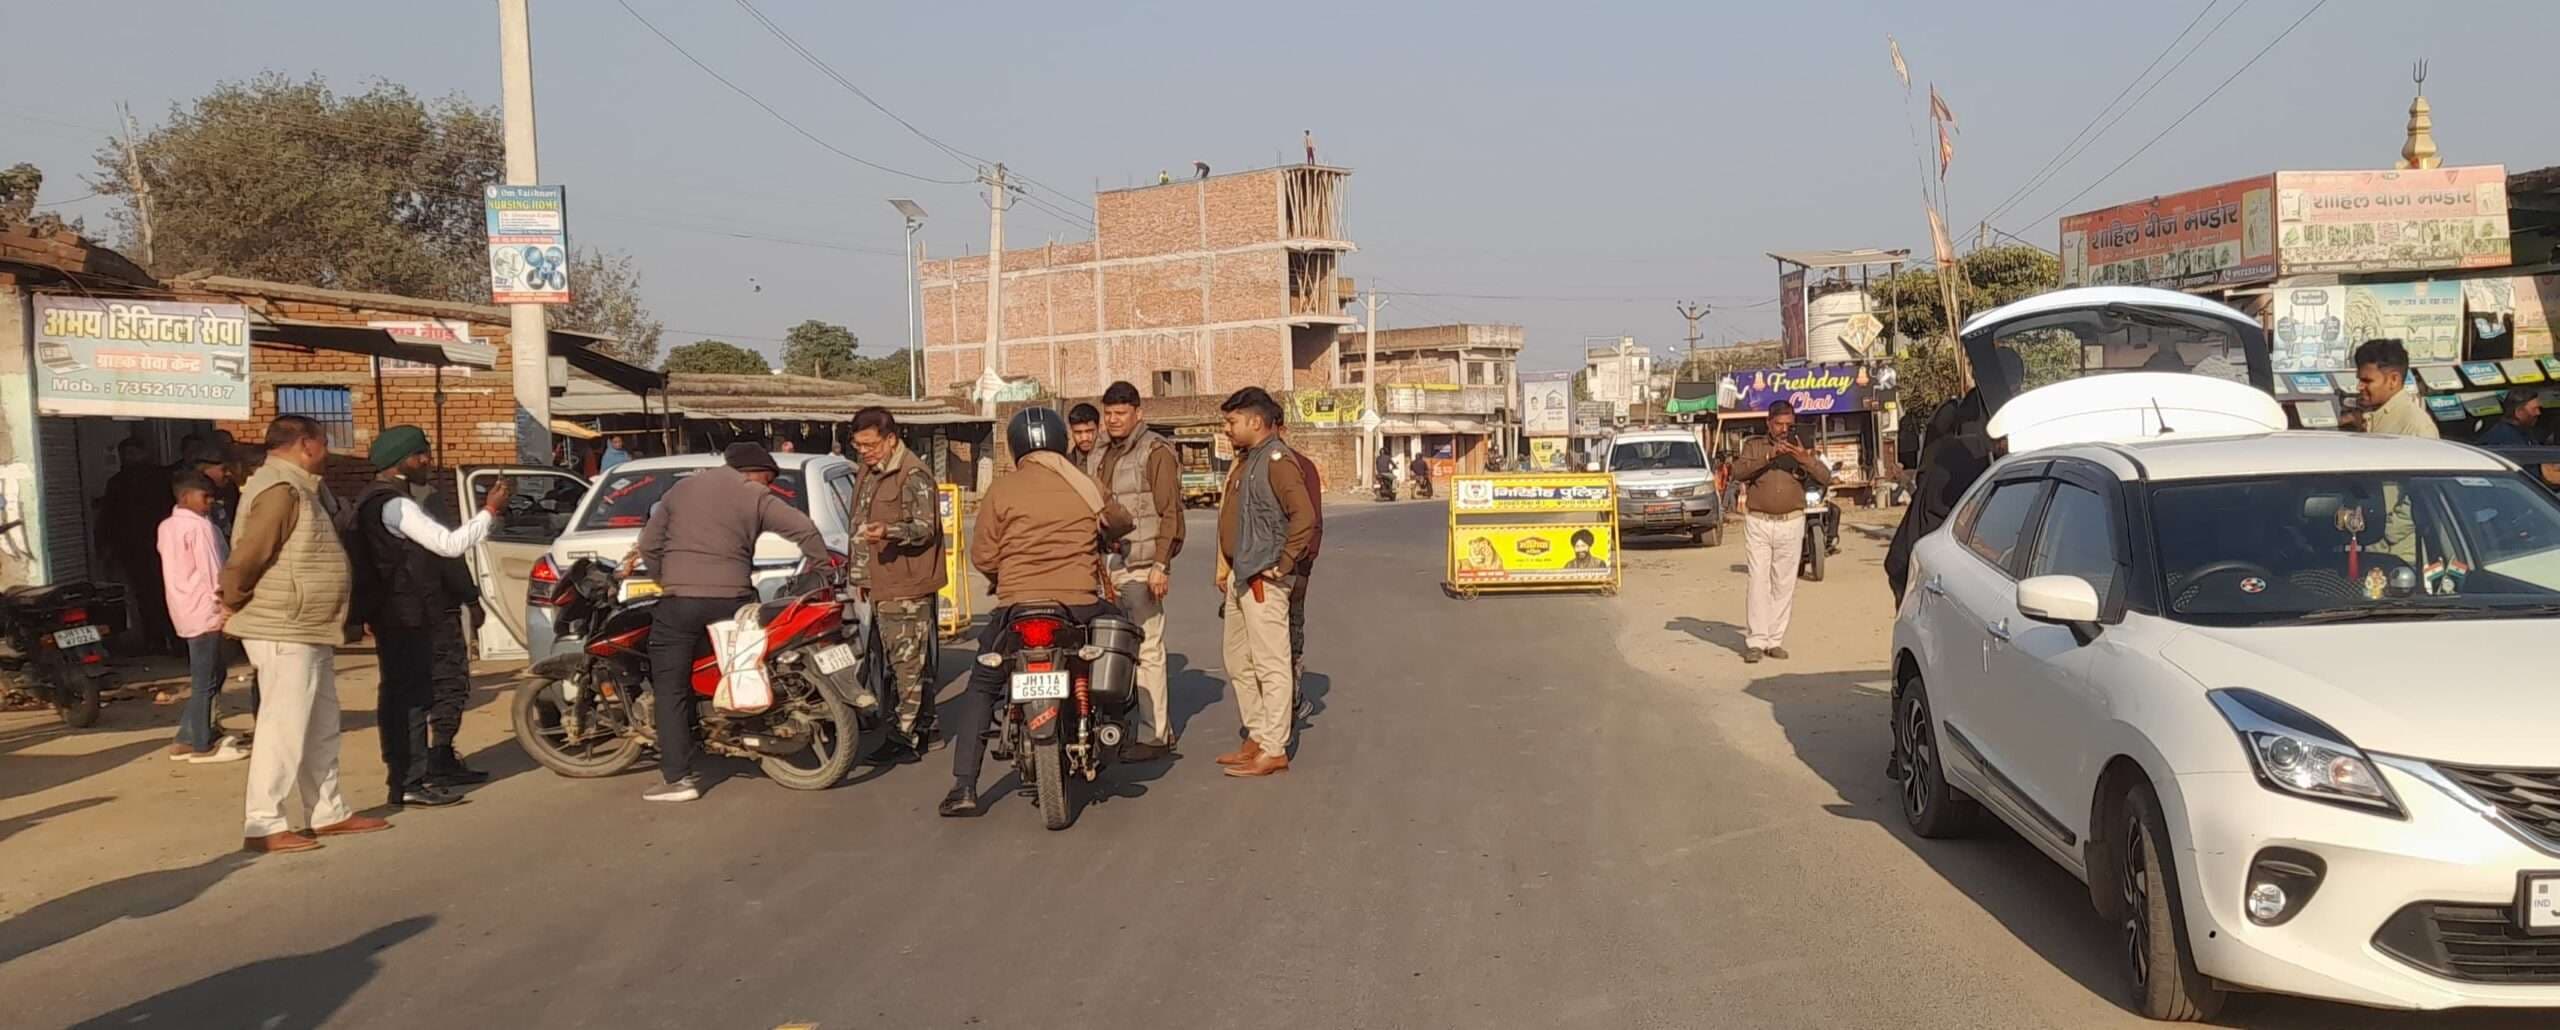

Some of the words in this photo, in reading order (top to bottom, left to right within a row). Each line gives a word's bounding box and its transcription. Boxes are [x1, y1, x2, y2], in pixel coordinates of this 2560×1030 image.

[487, 199, 529, 209] NURSING
[531, 199, 558, 209] HOME
[43, 307, 103, 338] अभय
[108, 303, 196, 344] डिजिटल
[200, 308, 244, 346] सेवा
[51, 377, 98, 392] Mob.
[117, 381, 235, 399] 7352171187
[1767, 370, 1853, 394] Freshday
[1789, 391, 1834, 413] Chai
[1022, 674, 1060, 686] JH11A
[1022, 686, 1060, 698] G5545
[2534, 899, 2551, 908] IND
